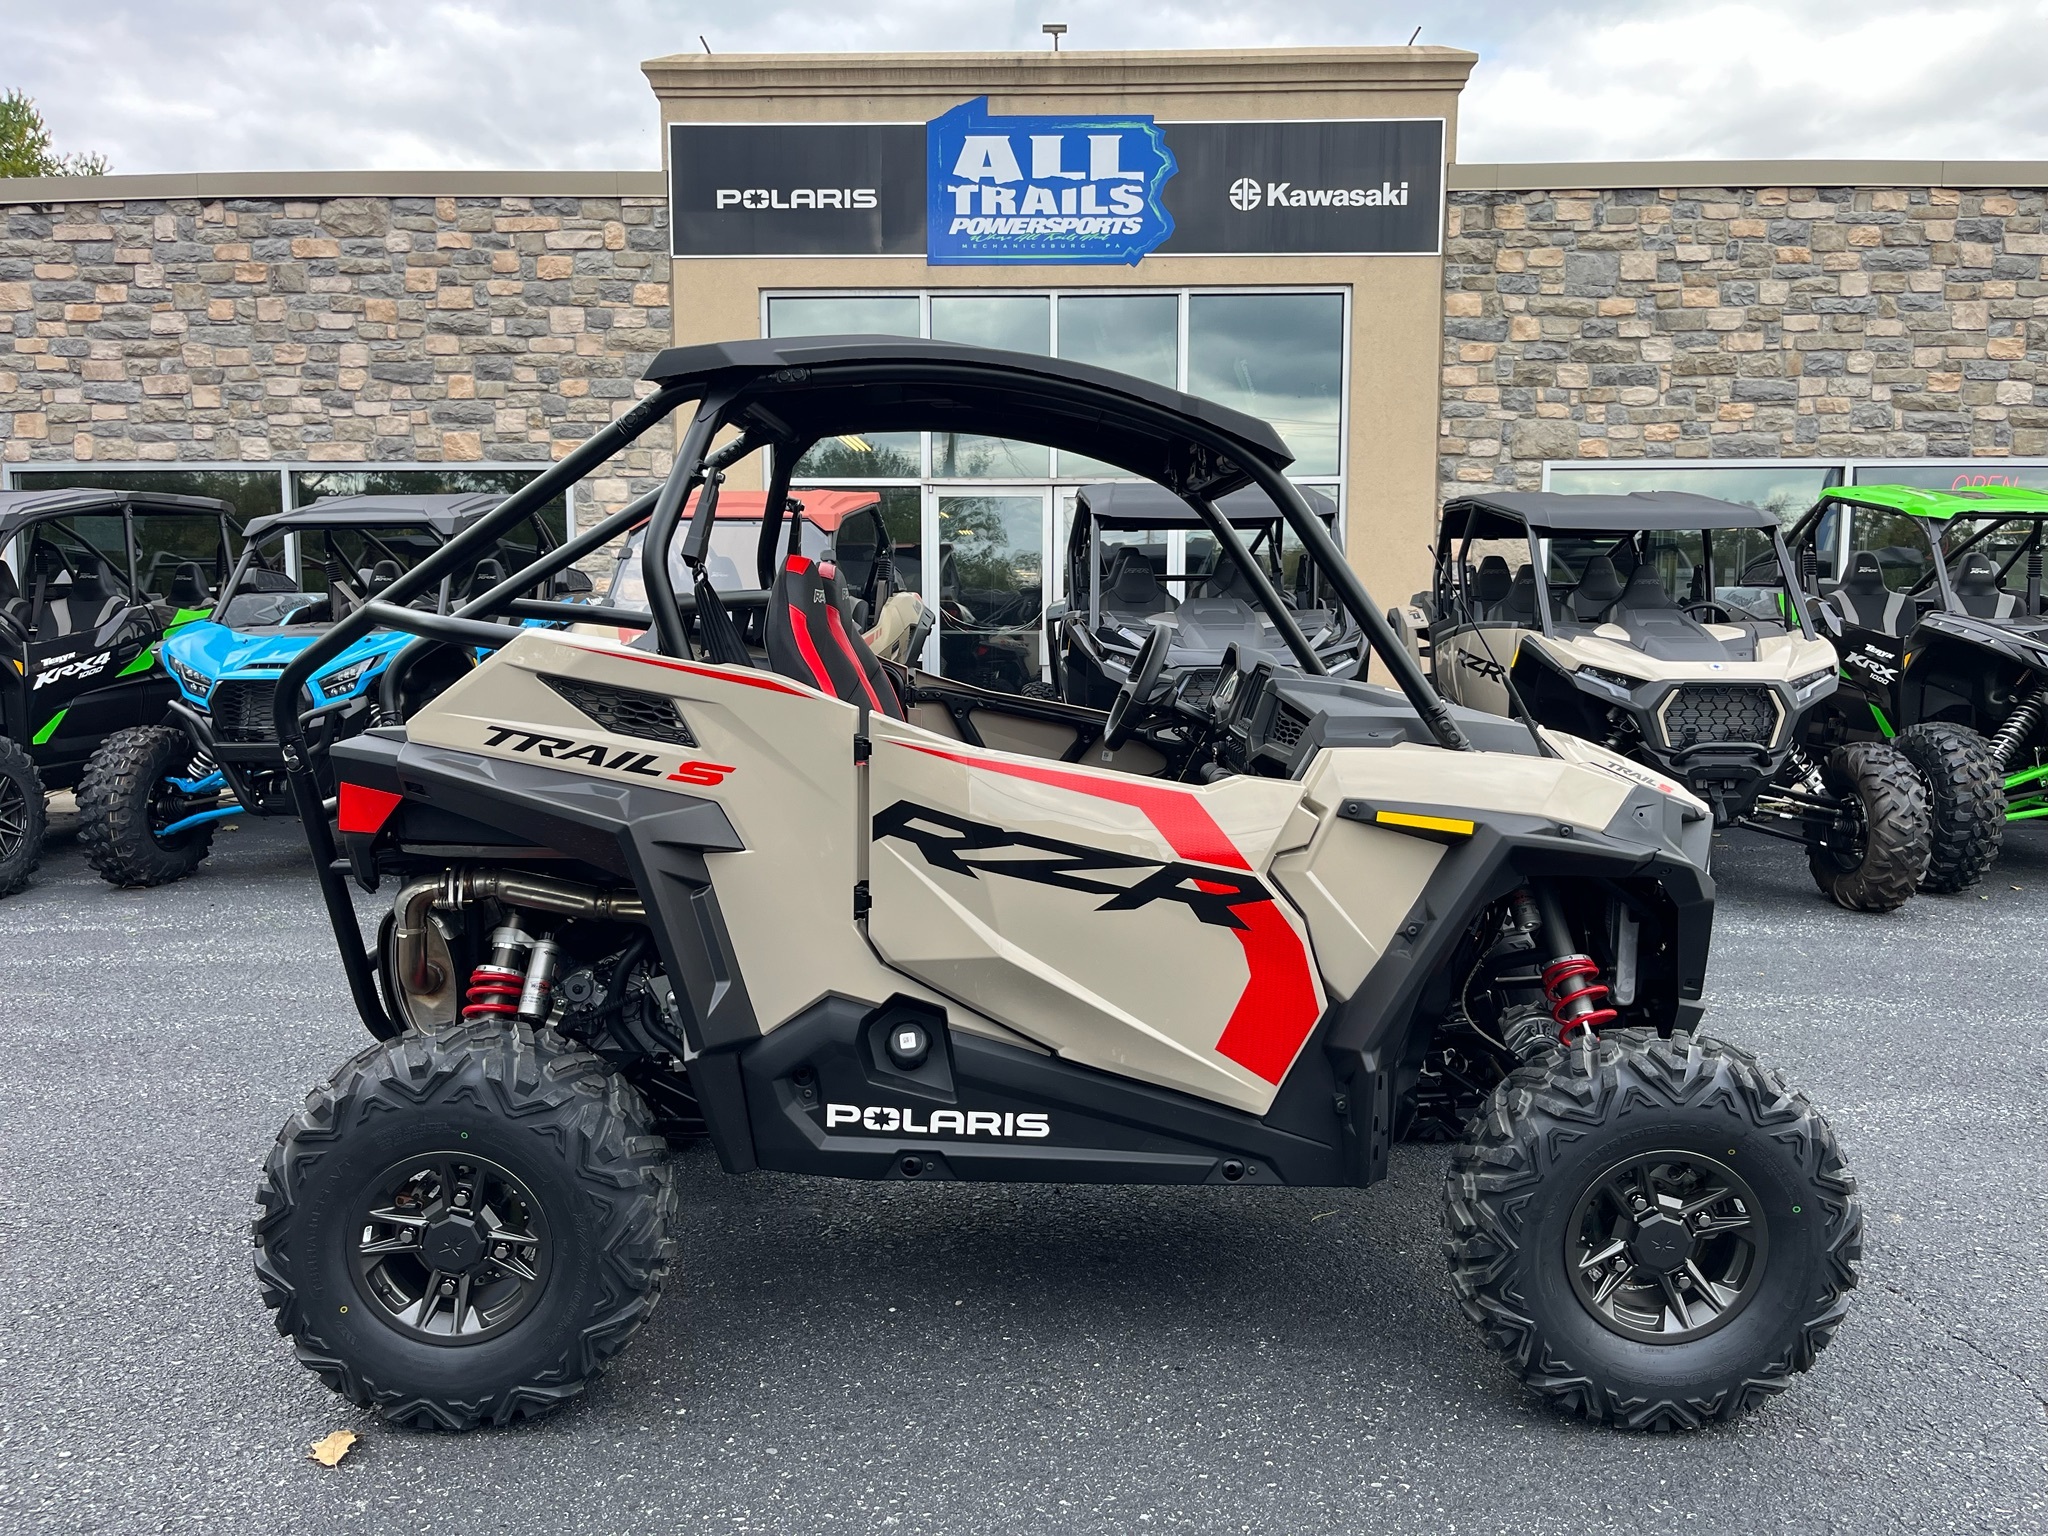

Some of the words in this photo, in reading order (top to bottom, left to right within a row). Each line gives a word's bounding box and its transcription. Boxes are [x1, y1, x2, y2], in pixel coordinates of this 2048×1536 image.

[952, 135, 1144, 184] ALL
[716, 189, 878, 209] POLARIS
[947, 184, 1144, 216] TRAILS
[1266, 182, 1409, 207] Kawasaki
[949, 217, 1144, 235] POWERSPORTS
[33, 651, 111, 690] KRX4
[78, 665, 104, 679] 1000
[1845, 651, 1899, 682] KRX
[1869, 672, 1889, 685] 1000
[484, 725, 663, 777] TRAIL
[666, 761, 737, 787] S
[1607, 760, 1657, 786] TRAIL
[1657, 783, 1674, 793] S
[872, 799, 1276, 931] RZR
[826, 1103, 1050, 1138] POLARIS
